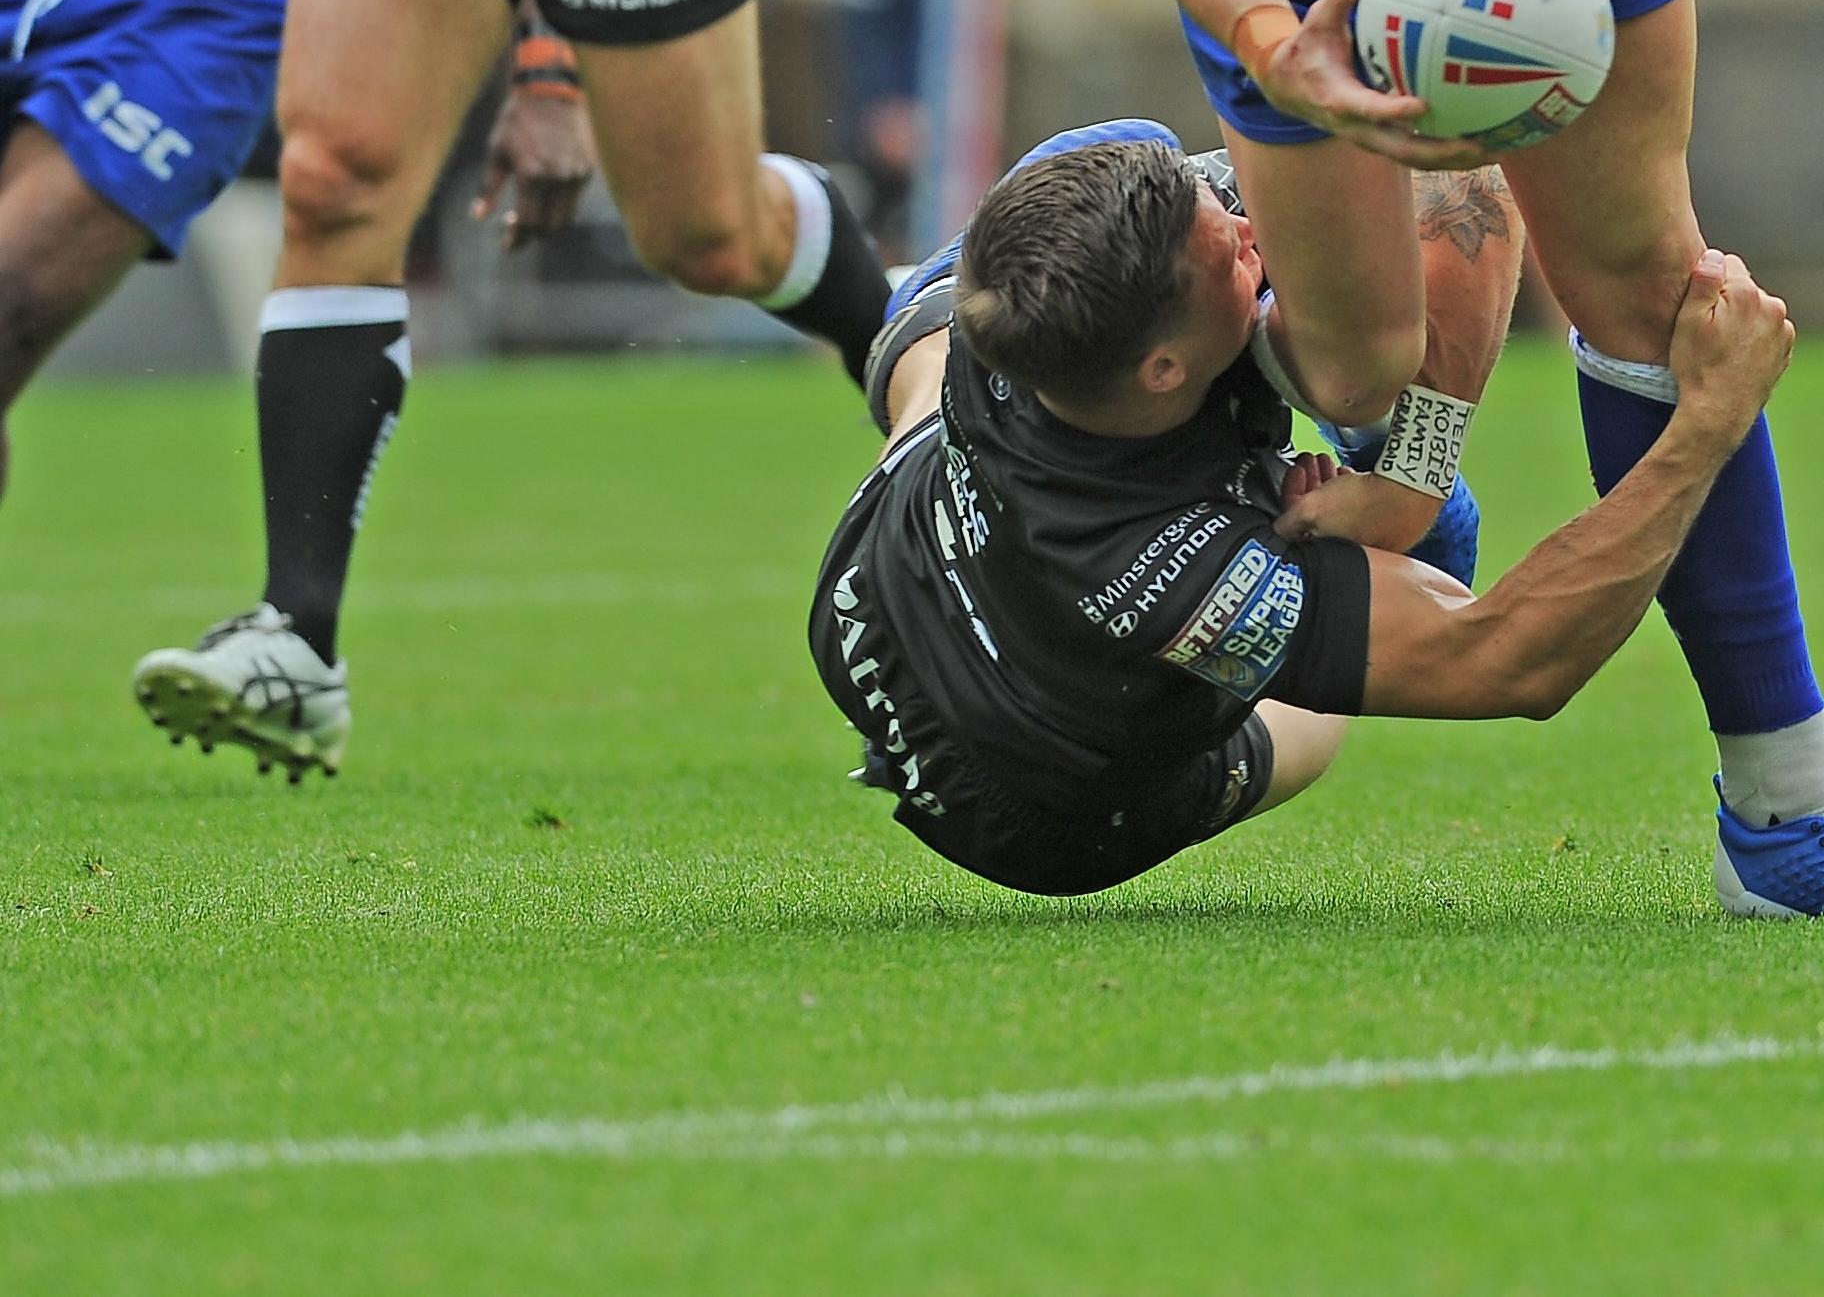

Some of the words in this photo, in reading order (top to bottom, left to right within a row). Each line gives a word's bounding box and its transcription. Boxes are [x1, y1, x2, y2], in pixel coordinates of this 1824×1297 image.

[82, 79, 194, 182] ISC
[1396, 395, 1434, 483] FAMILY
[1135, 514, 1233, 613] HYUNDAI
[1223, 567, 1297, 657] SUPER
